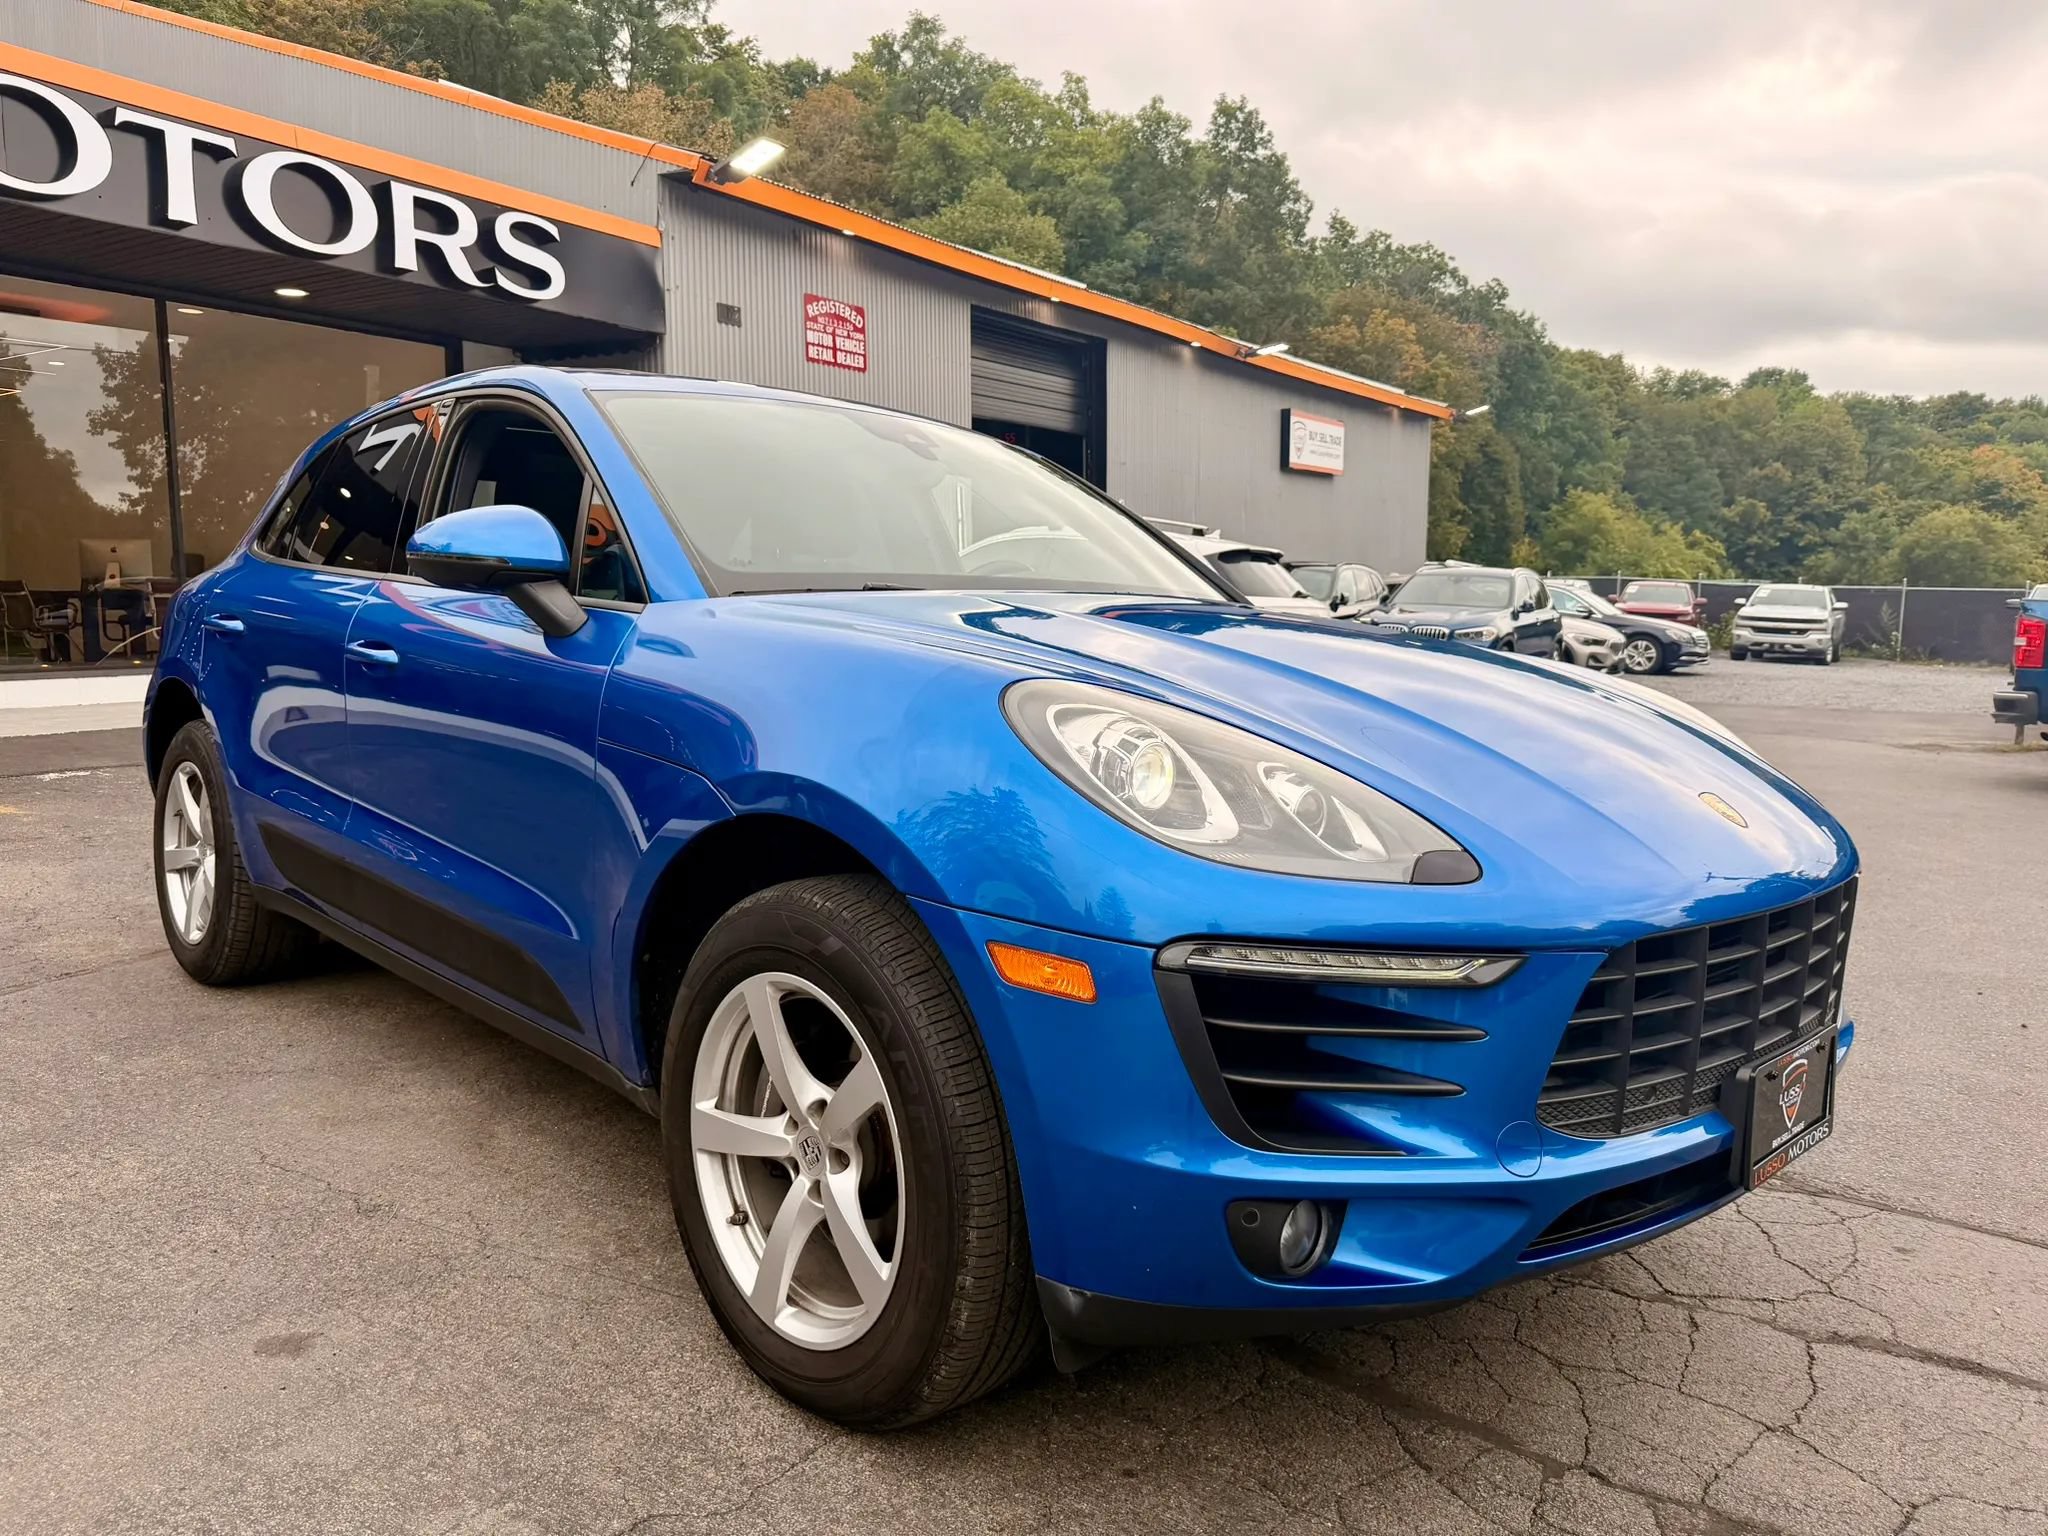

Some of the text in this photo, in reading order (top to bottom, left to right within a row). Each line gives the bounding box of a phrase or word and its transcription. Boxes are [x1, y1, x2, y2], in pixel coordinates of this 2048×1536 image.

[806, 300, 864, 328] REGISTERED
[806, 321, 865, 341] STATE OF NEW YORK
[806, 329, 865, 355] MOTOR VEHICLE
[808, 344, 865, 368] RETAIL DEALER
[1754, 1122, 1830, 1185] LUSSO MOTORS
